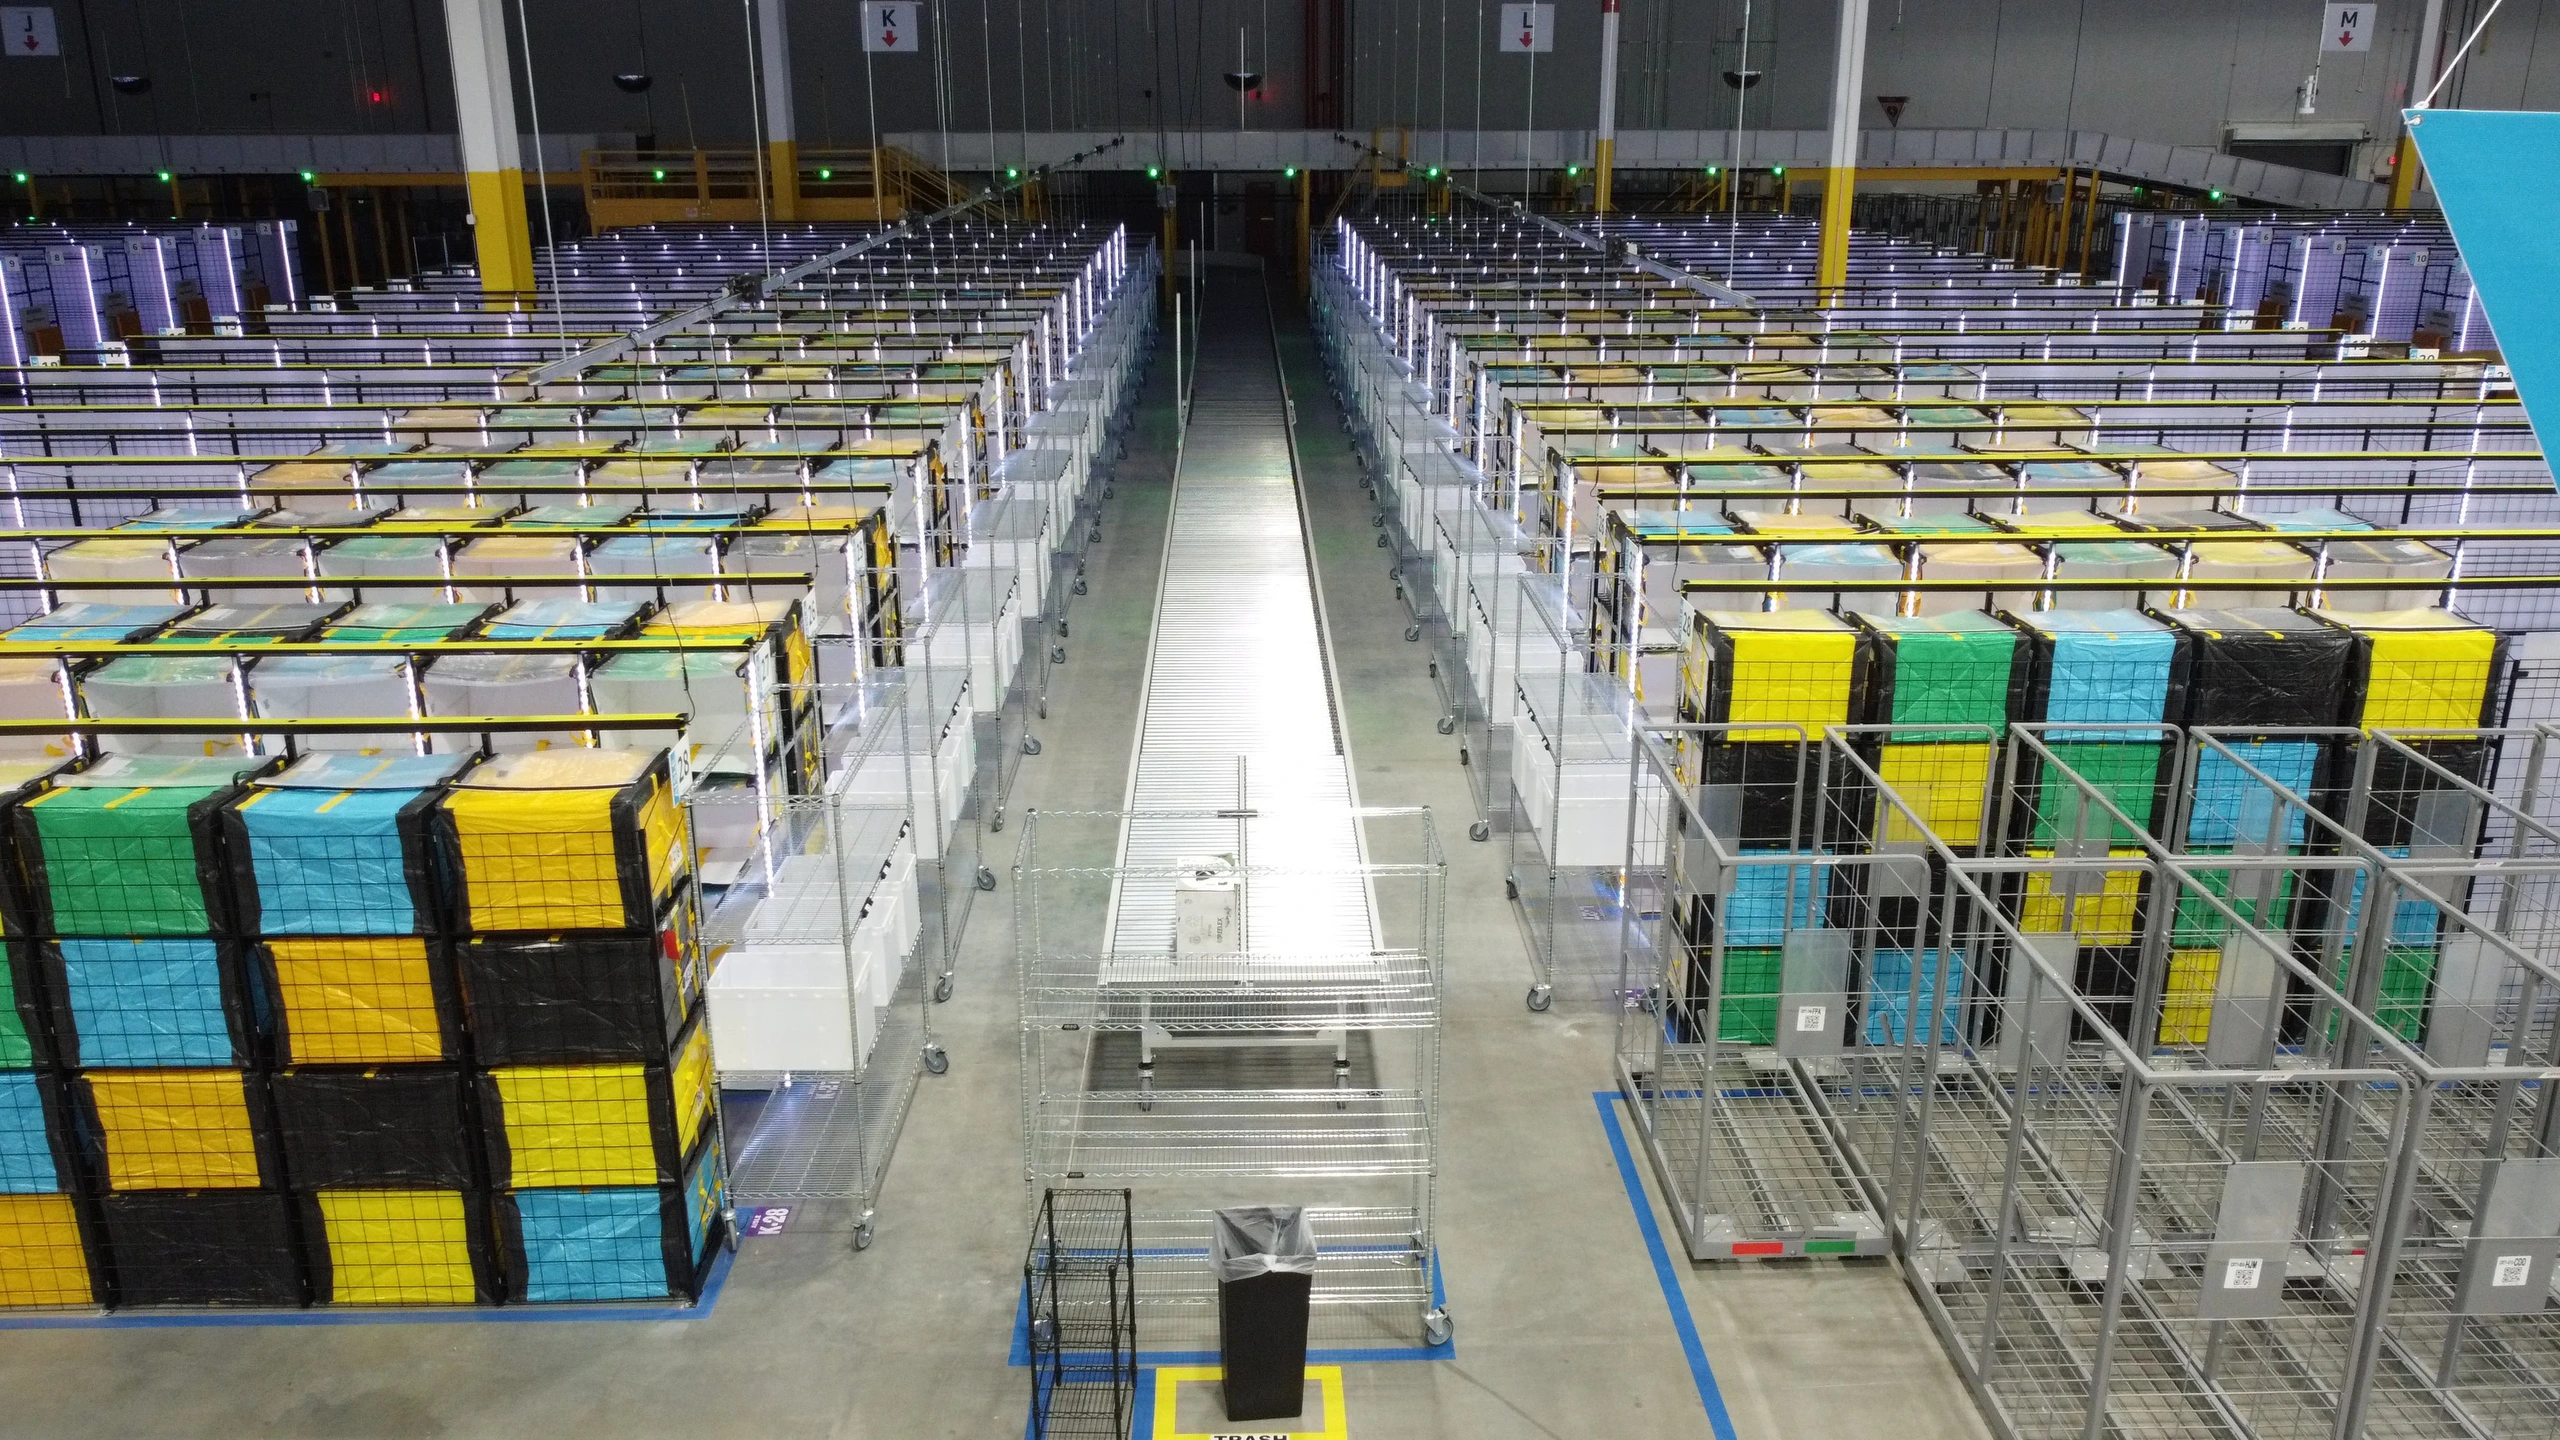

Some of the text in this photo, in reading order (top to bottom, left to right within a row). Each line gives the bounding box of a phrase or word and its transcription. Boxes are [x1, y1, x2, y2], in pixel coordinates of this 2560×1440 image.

[24, 15, 33, 32] J
[882, 9, 897, 27] K
[1523, 12, 1533, 28] L
[2341, 11, 2358, 28] M
[1683, 612, 1691, 637] 28
[678, 749, 689, 783] 28
